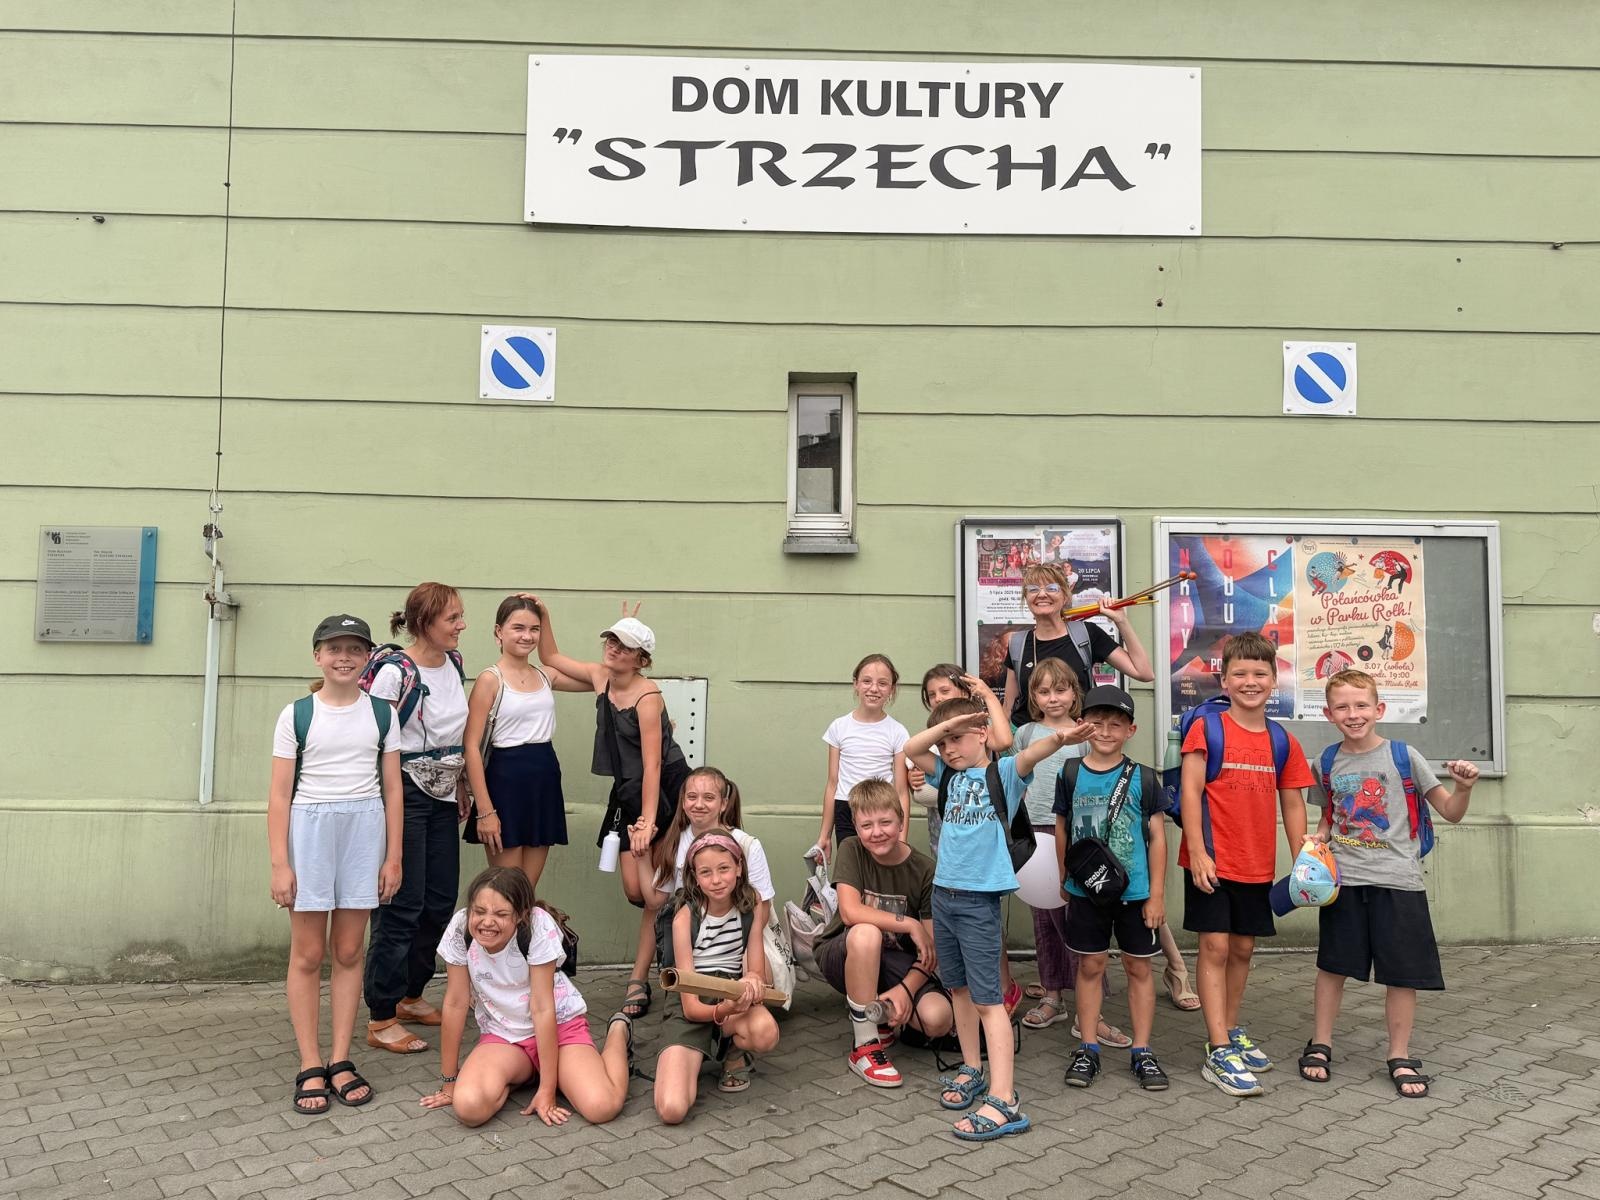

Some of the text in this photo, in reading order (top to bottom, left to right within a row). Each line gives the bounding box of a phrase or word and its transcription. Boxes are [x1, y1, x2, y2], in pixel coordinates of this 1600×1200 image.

[671, 76, 1064, 119] DOM KULTURY
[1321, 587, 1399, 609] Potańcówka
[1310, 601, 1412, 626] w Parku Roth!
[1383, 661, 1415, 672] (sobota)
[1109, 777, 1128, 807] Reebok
[1084, 863, 1108, 888] Reebok
